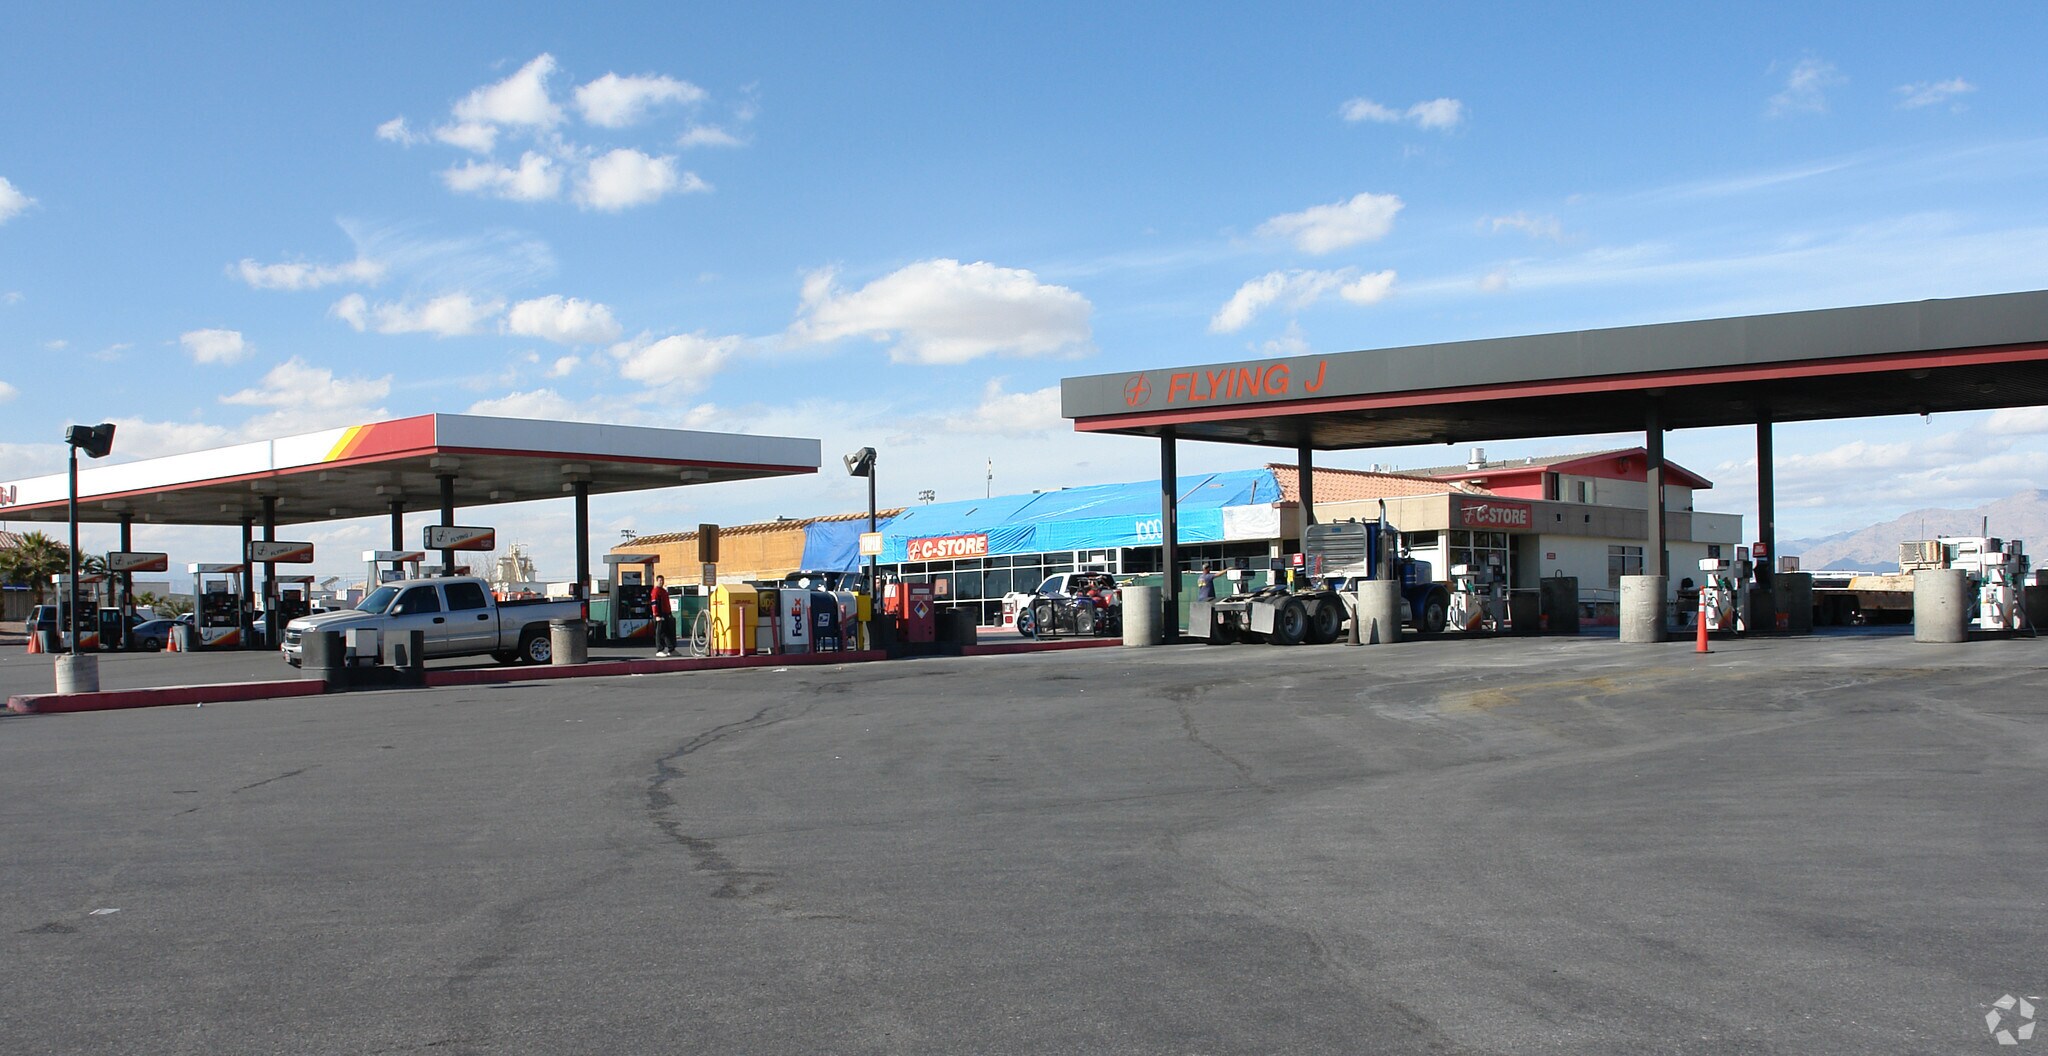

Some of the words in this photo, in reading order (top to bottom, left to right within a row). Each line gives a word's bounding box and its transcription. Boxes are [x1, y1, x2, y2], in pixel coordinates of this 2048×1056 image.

[1167, 364, 1290, 403] FLYING
[1304, 361, 1327, 393] J
[1476, 506, 1527, 524] C-STORE
[921, 535, 987, 558] C-STORE
[791, 598, 802, 637] FedEx
